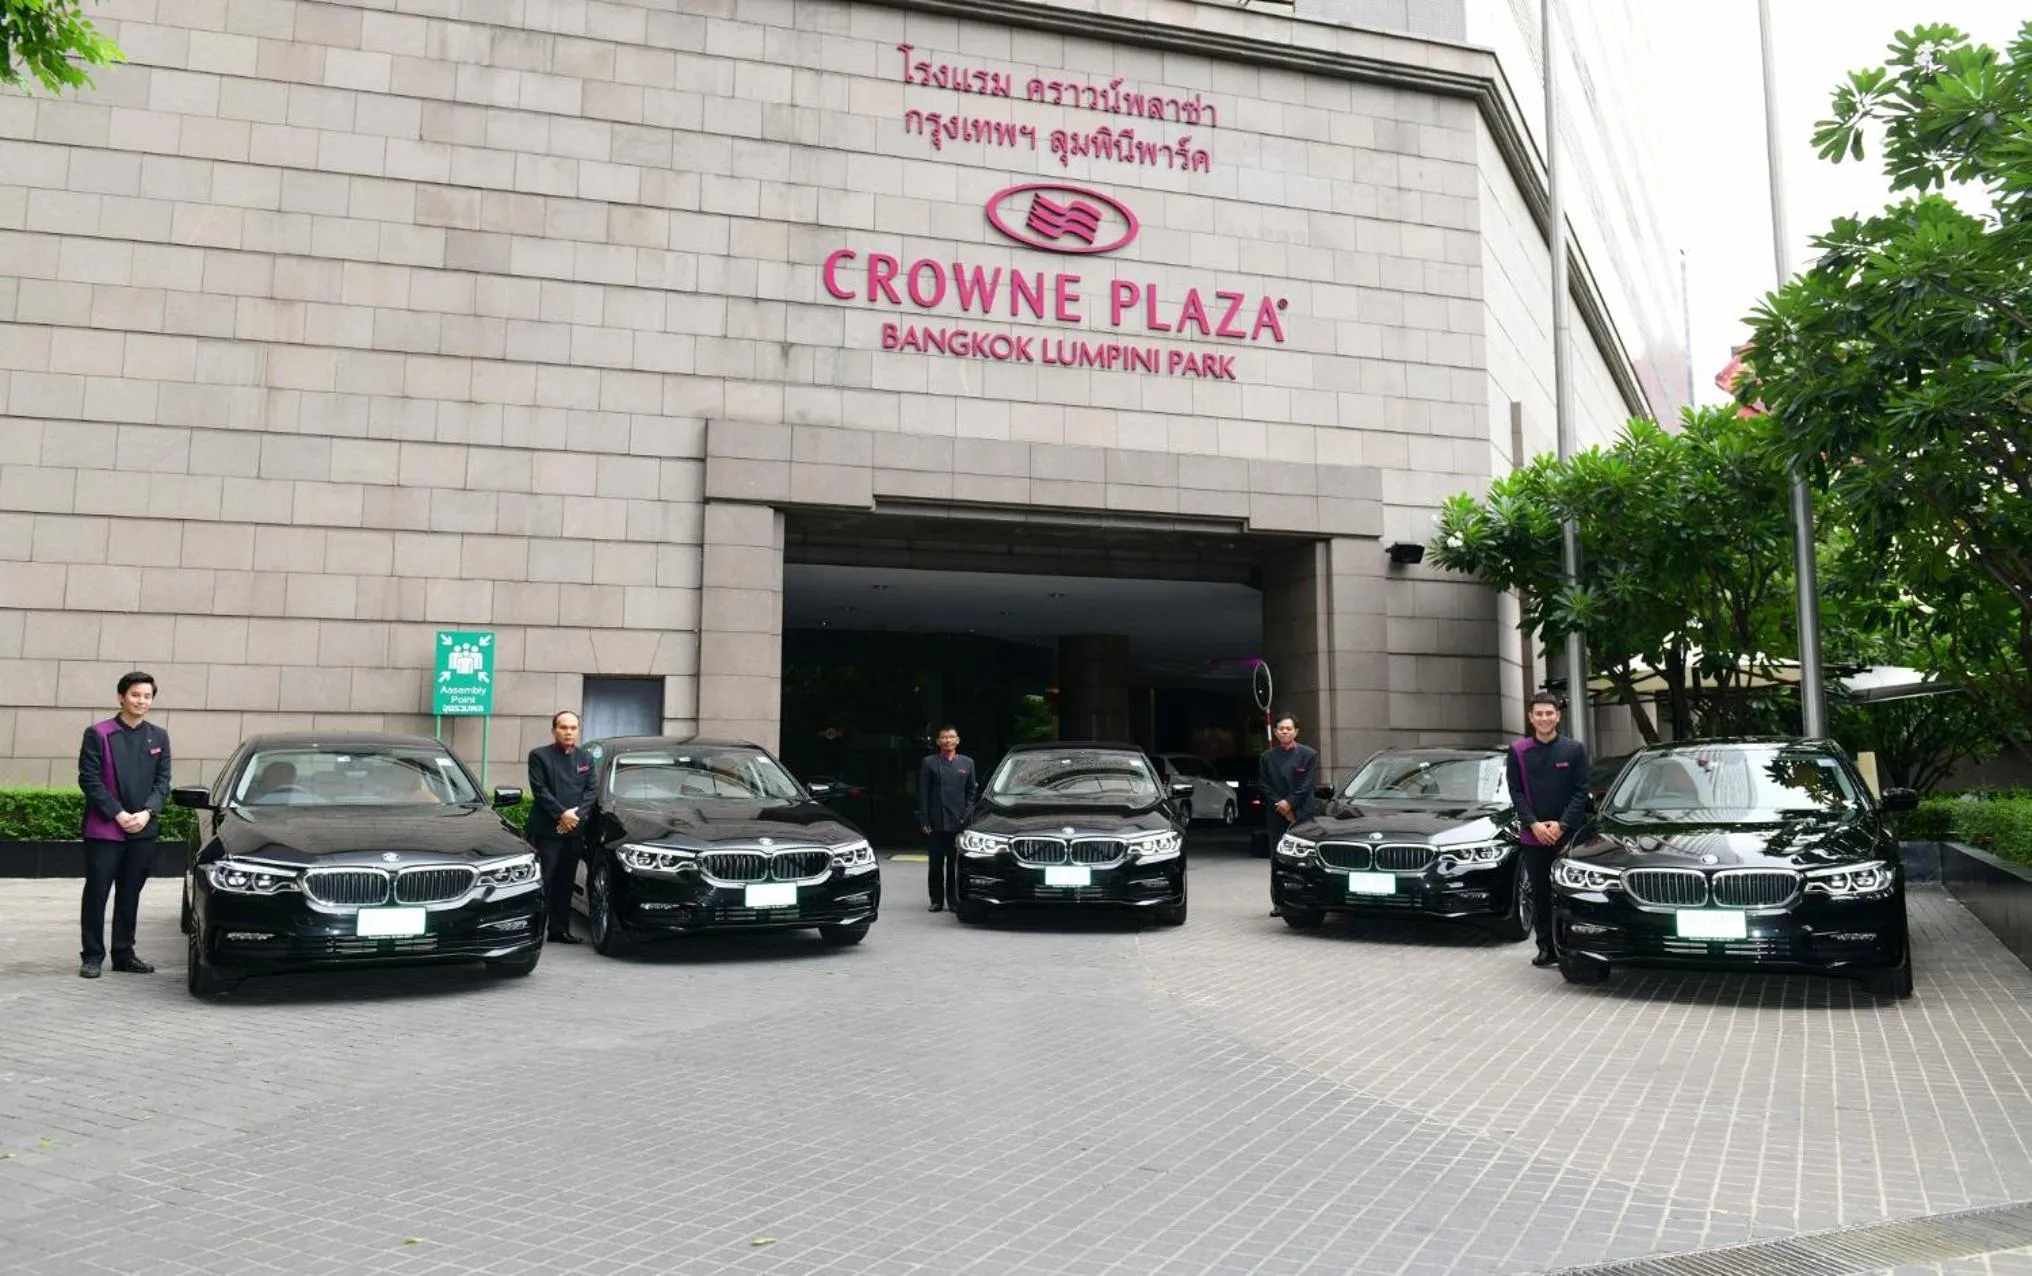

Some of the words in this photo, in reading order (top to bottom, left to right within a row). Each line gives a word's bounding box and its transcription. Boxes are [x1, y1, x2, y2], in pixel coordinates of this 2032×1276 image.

[898, 43, 1013, 98] โรงแรม
[1026, 77, 1219, 128] คราวน์พลาซ่า
[904, 107, 1037, 151] กรุงเทพฯ
[1049, 125, 1211, 174] ลุมพินีพาร์ค
[823, 247, 1083, 323] CROWNE
[881, 321, 1034, 363] BANGKOK
[1041, 336, 1161, 374] LUMPINI
[1167, 348, 1236, 380] PARK
[440, 686, 487, 696] Assembly
[450, 695, 475, 703] Point
